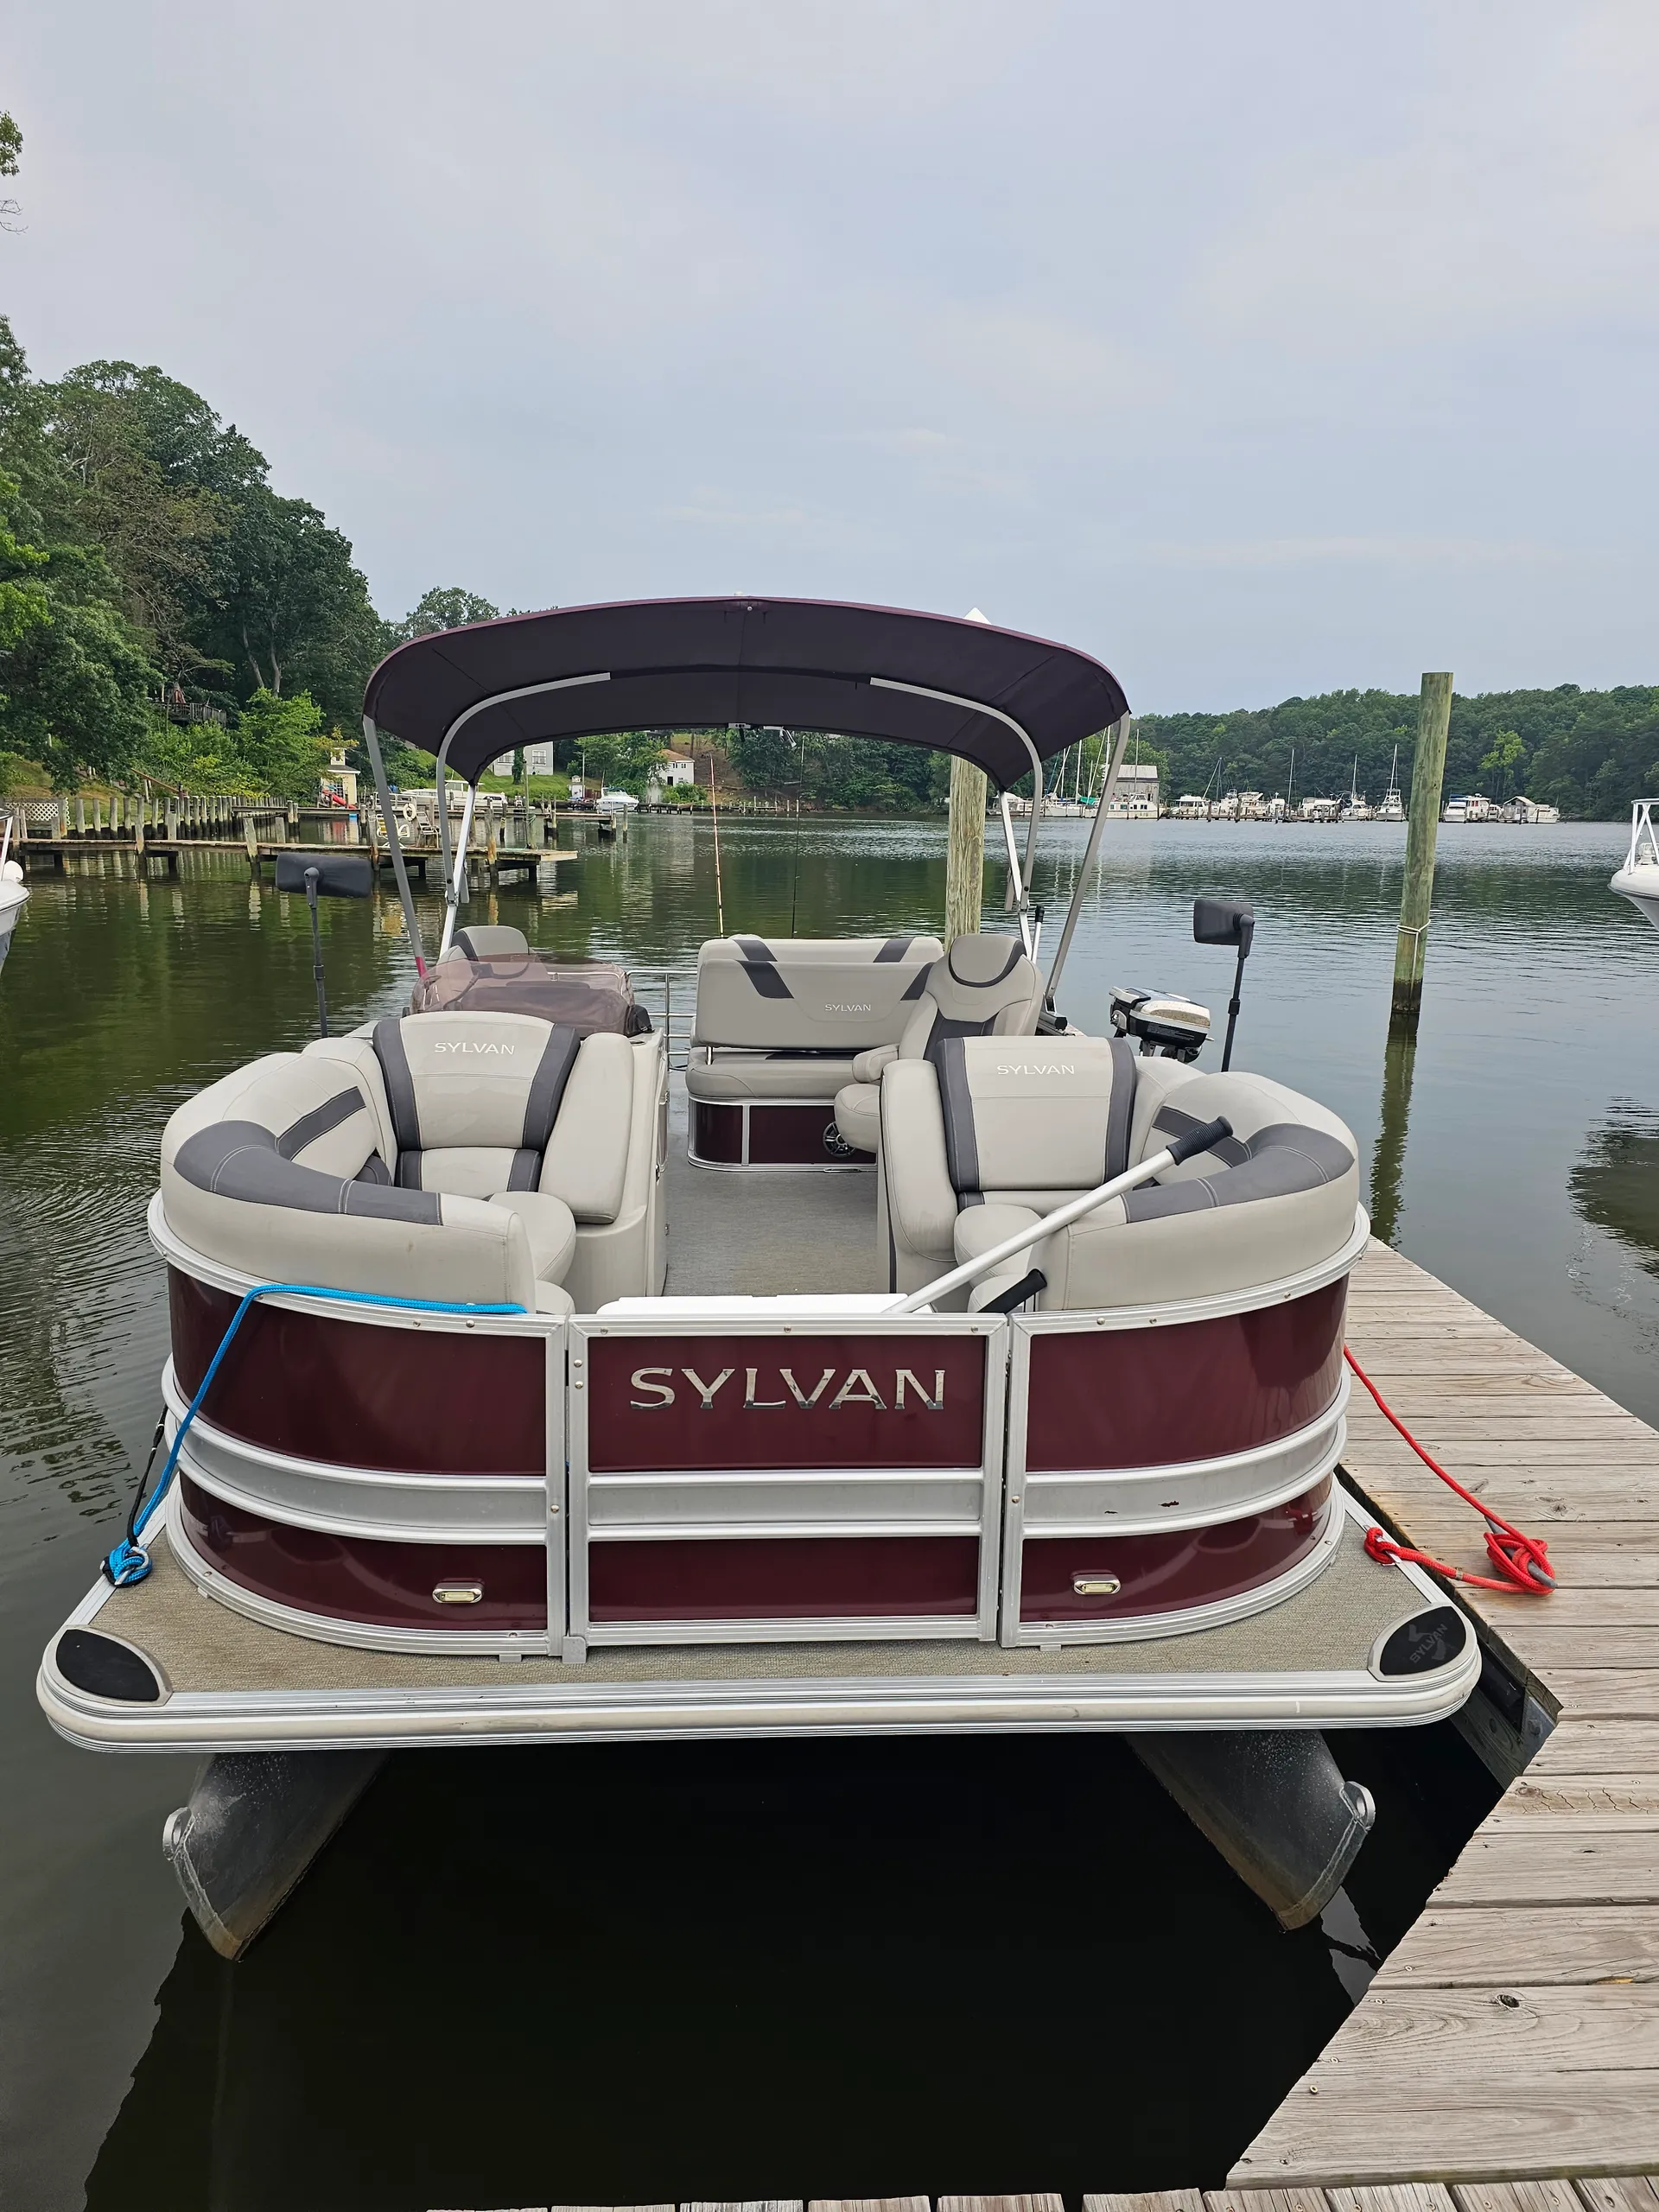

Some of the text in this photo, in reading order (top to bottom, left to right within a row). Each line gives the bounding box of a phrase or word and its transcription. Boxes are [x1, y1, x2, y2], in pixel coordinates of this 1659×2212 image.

[434, 1042, 516, 1055] SYLVAN
[996, 1065, 1075, 1075] SYLVAN
[630, 1367, 946, 1410] SYLVAN
[1409, 1624, 1448, 1663] SYLVAN
